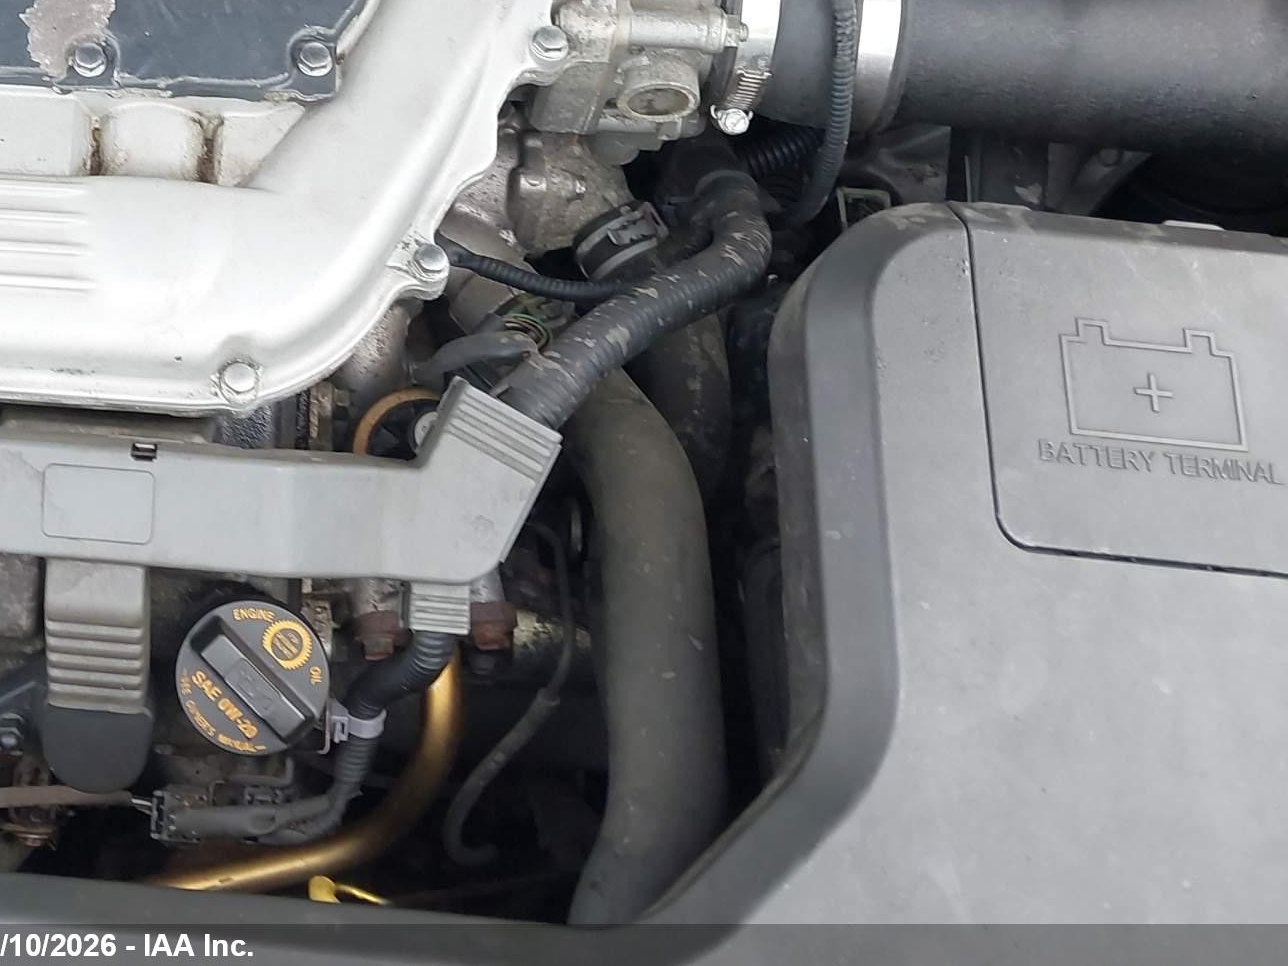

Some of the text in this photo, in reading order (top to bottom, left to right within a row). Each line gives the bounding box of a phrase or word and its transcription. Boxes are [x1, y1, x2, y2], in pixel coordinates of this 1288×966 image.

[1037, 438, 1286, 485] BATTERY TERMINAL
[232, 607, 276, 623] ENGINE
[309, 665, 323, 685] OIL
[191, 670, 259, 739] SAE 0W-20
